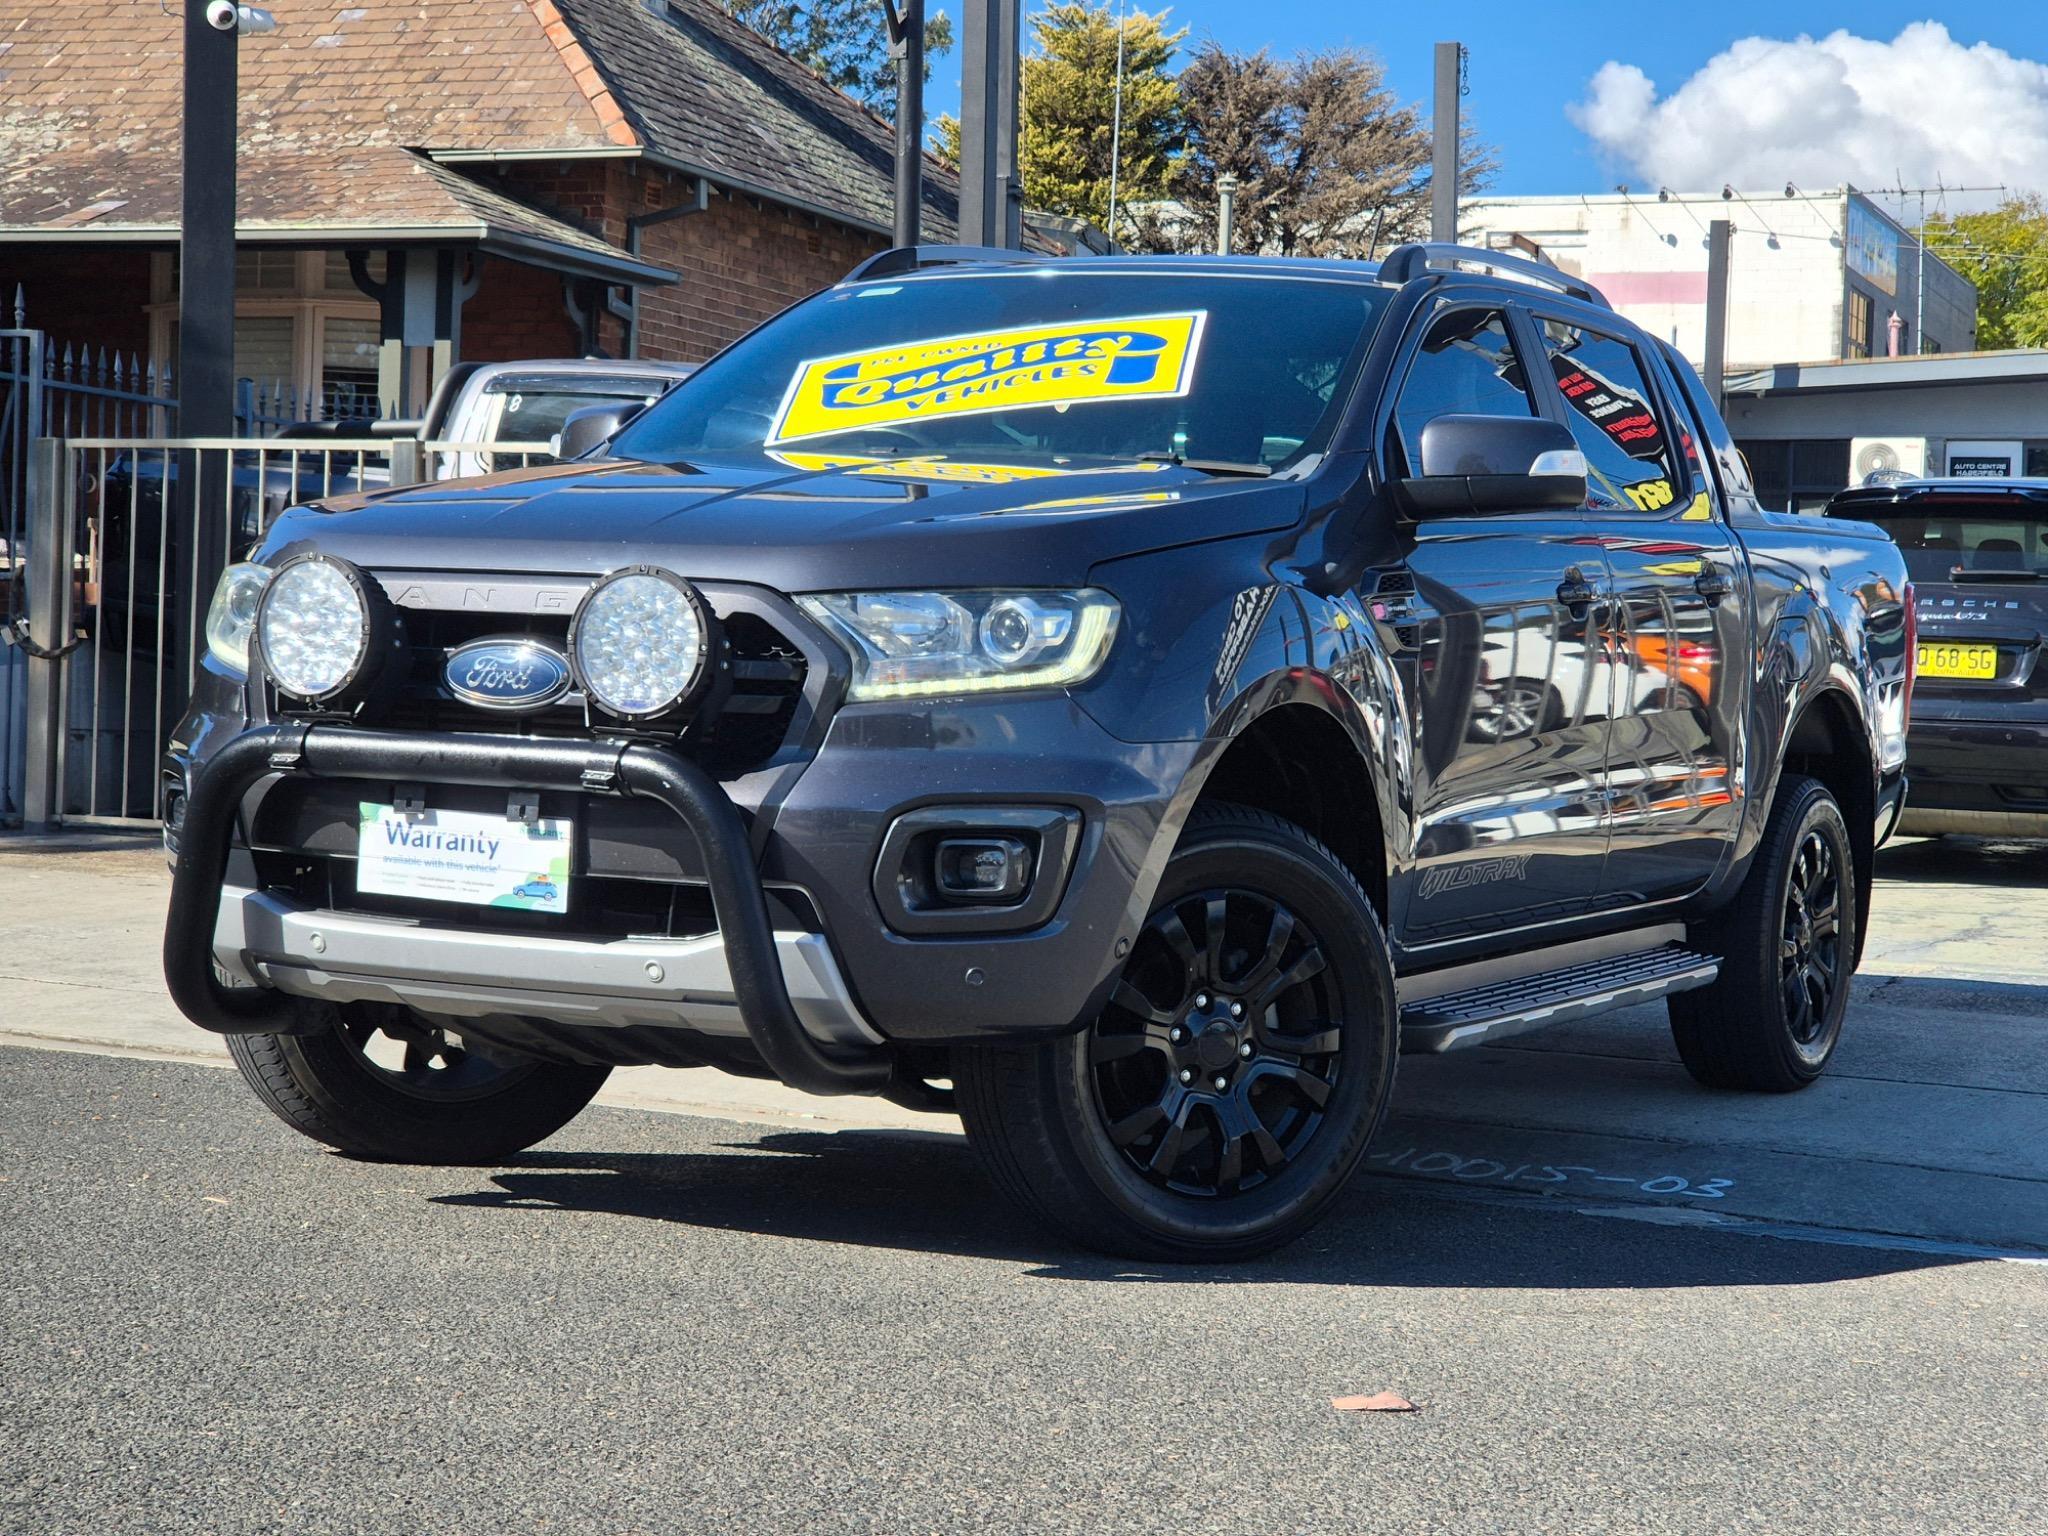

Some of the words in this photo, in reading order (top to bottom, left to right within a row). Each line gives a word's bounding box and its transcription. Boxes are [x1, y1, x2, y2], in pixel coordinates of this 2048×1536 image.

[834, 333, 1133, 404] Quality
[906, 363, 1099, 411] VEHICLES
[394, 586, 571, 609] ANG
[466, 655, 534, 689] Ford
[385, 819, 500, 860] Warranty
[1419, 852, 1533, 900] WILDTRAK
